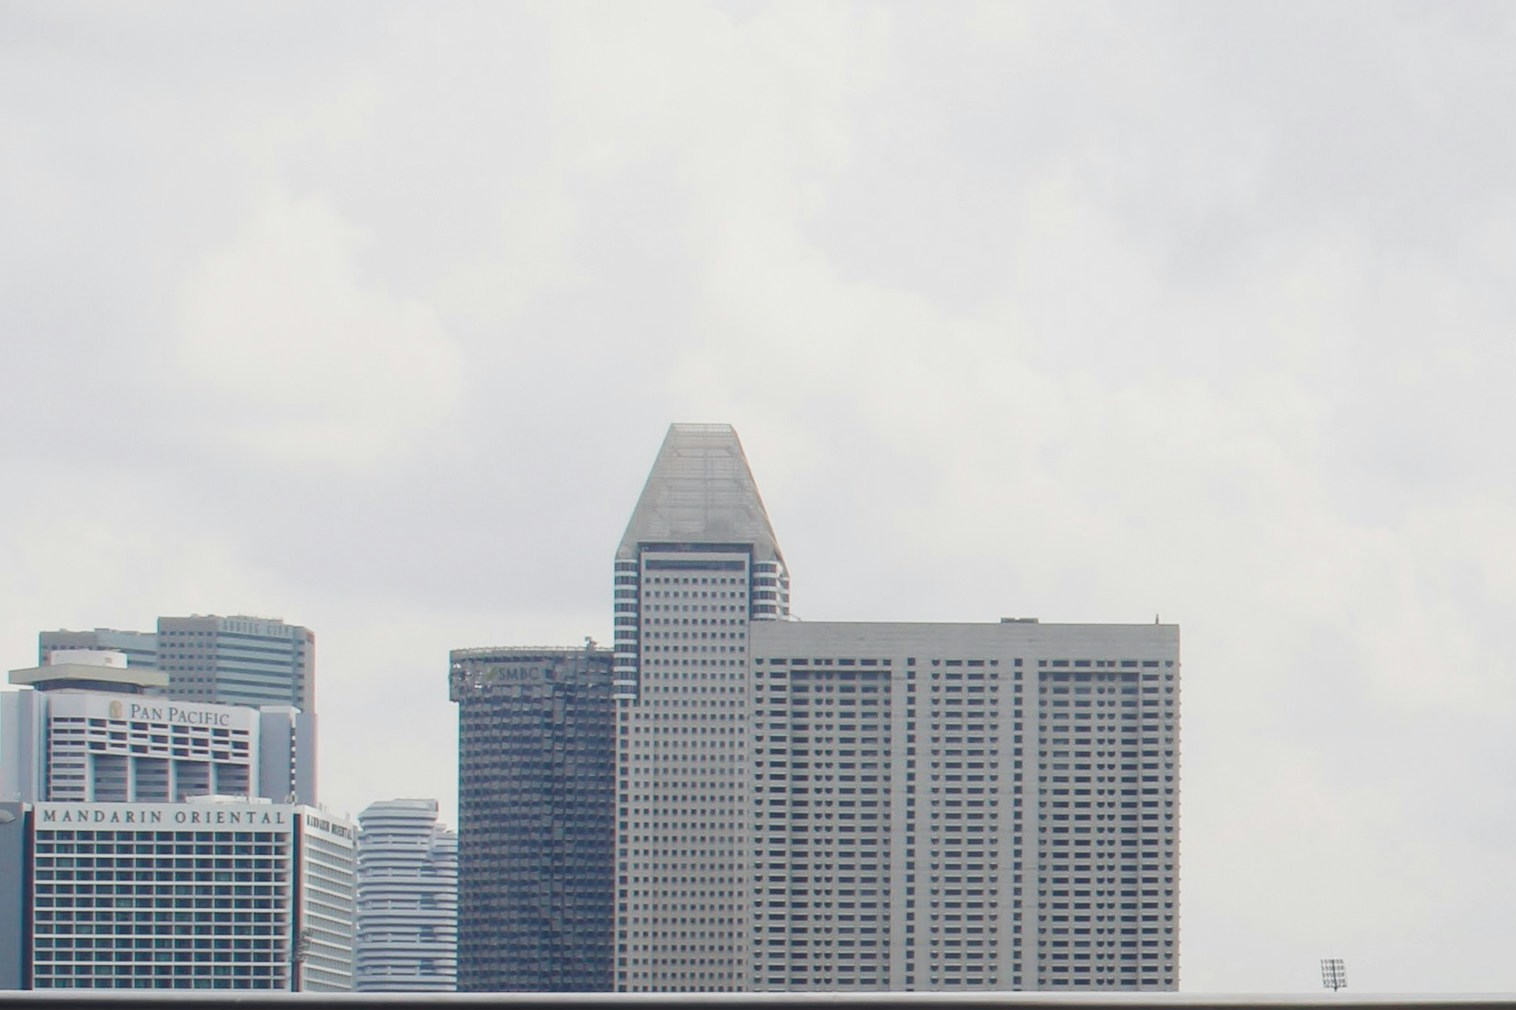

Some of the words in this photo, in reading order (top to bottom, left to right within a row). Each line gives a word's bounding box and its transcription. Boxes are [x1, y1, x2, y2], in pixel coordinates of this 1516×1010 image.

[499, 667, 540, 681] SMBC
[131, 703, 163, 720] PAN
[168, 706, 230, 727] PACIFIC
[43, 809, 163, 823] MANDARIN
[174, 810, 286, 824] ORIENTAL
